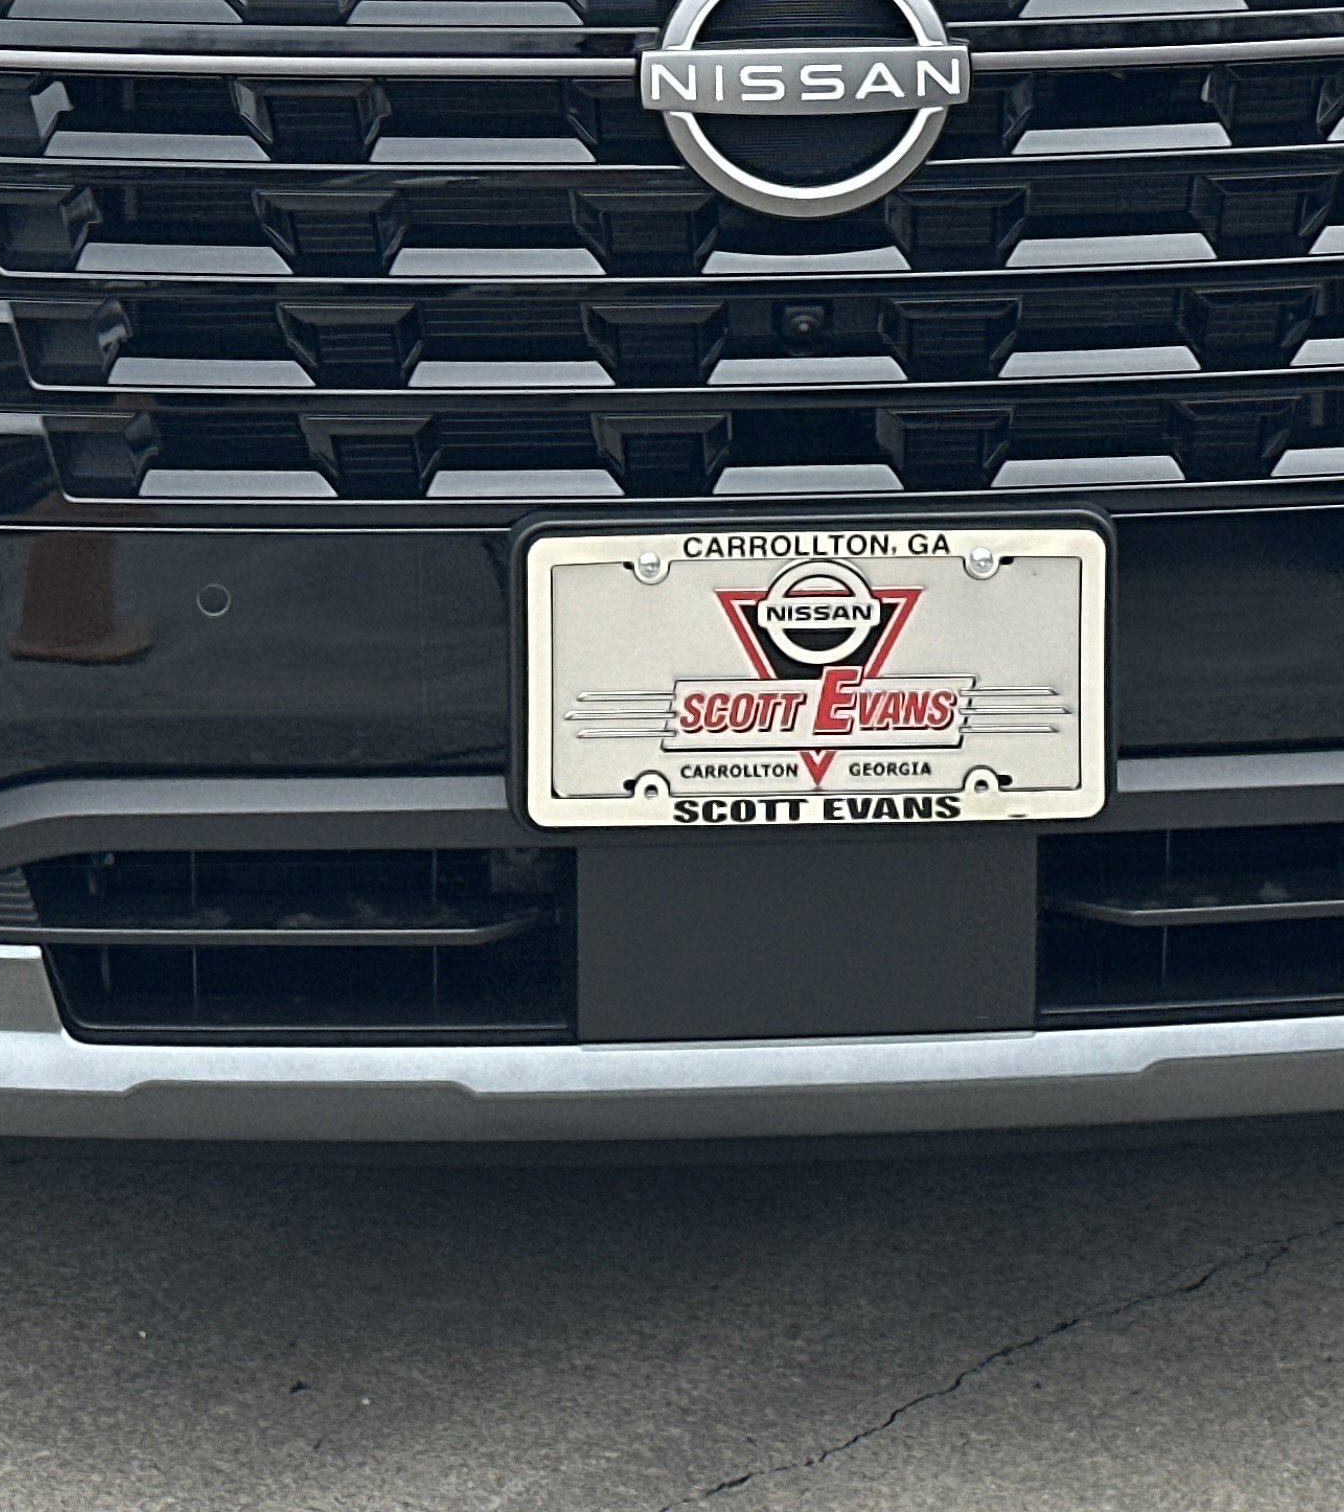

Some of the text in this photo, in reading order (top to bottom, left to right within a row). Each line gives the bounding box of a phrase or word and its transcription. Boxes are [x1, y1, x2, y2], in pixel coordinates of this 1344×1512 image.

[651, 58, 960, 101] NISSAN
[683, 533, 951, 558] CARROLLTON, GA
[766, 604, 873, 622] NISSAN
[679, 665, 958, 736] SCOTT EVANS
[680, 761, 932, 780] CARROLLTON GEORGIA
[673, 795, 962, 824] SCOTT EVANS
